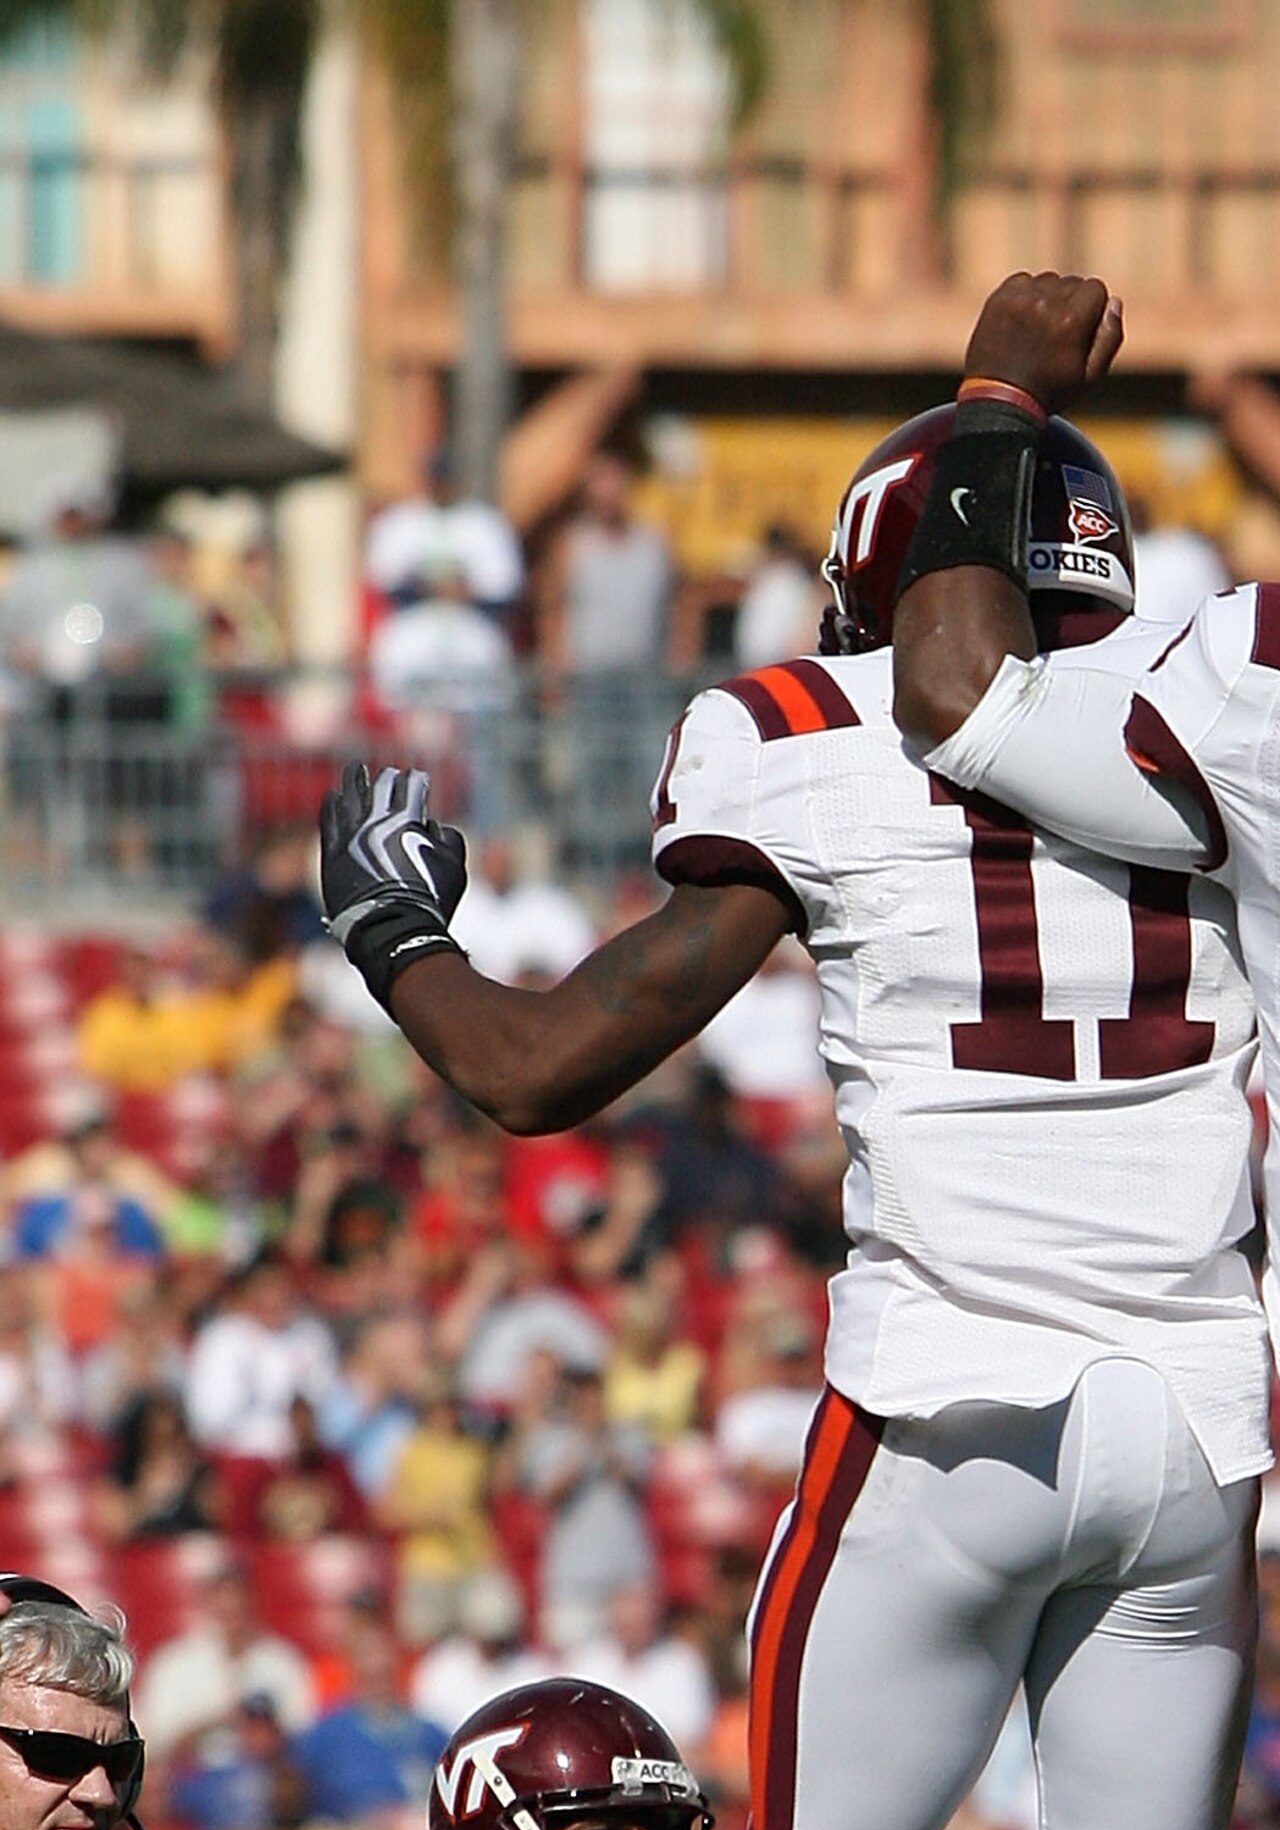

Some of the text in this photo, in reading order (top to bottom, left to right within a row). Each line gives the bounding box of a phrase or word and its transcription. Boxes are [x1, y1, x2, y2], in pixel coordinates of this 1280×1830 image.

[1077, 513, 1106, 533] ACC
[1029, 549, 1110, 578] OKIES
[928, 770, 1217, 1082] 11
